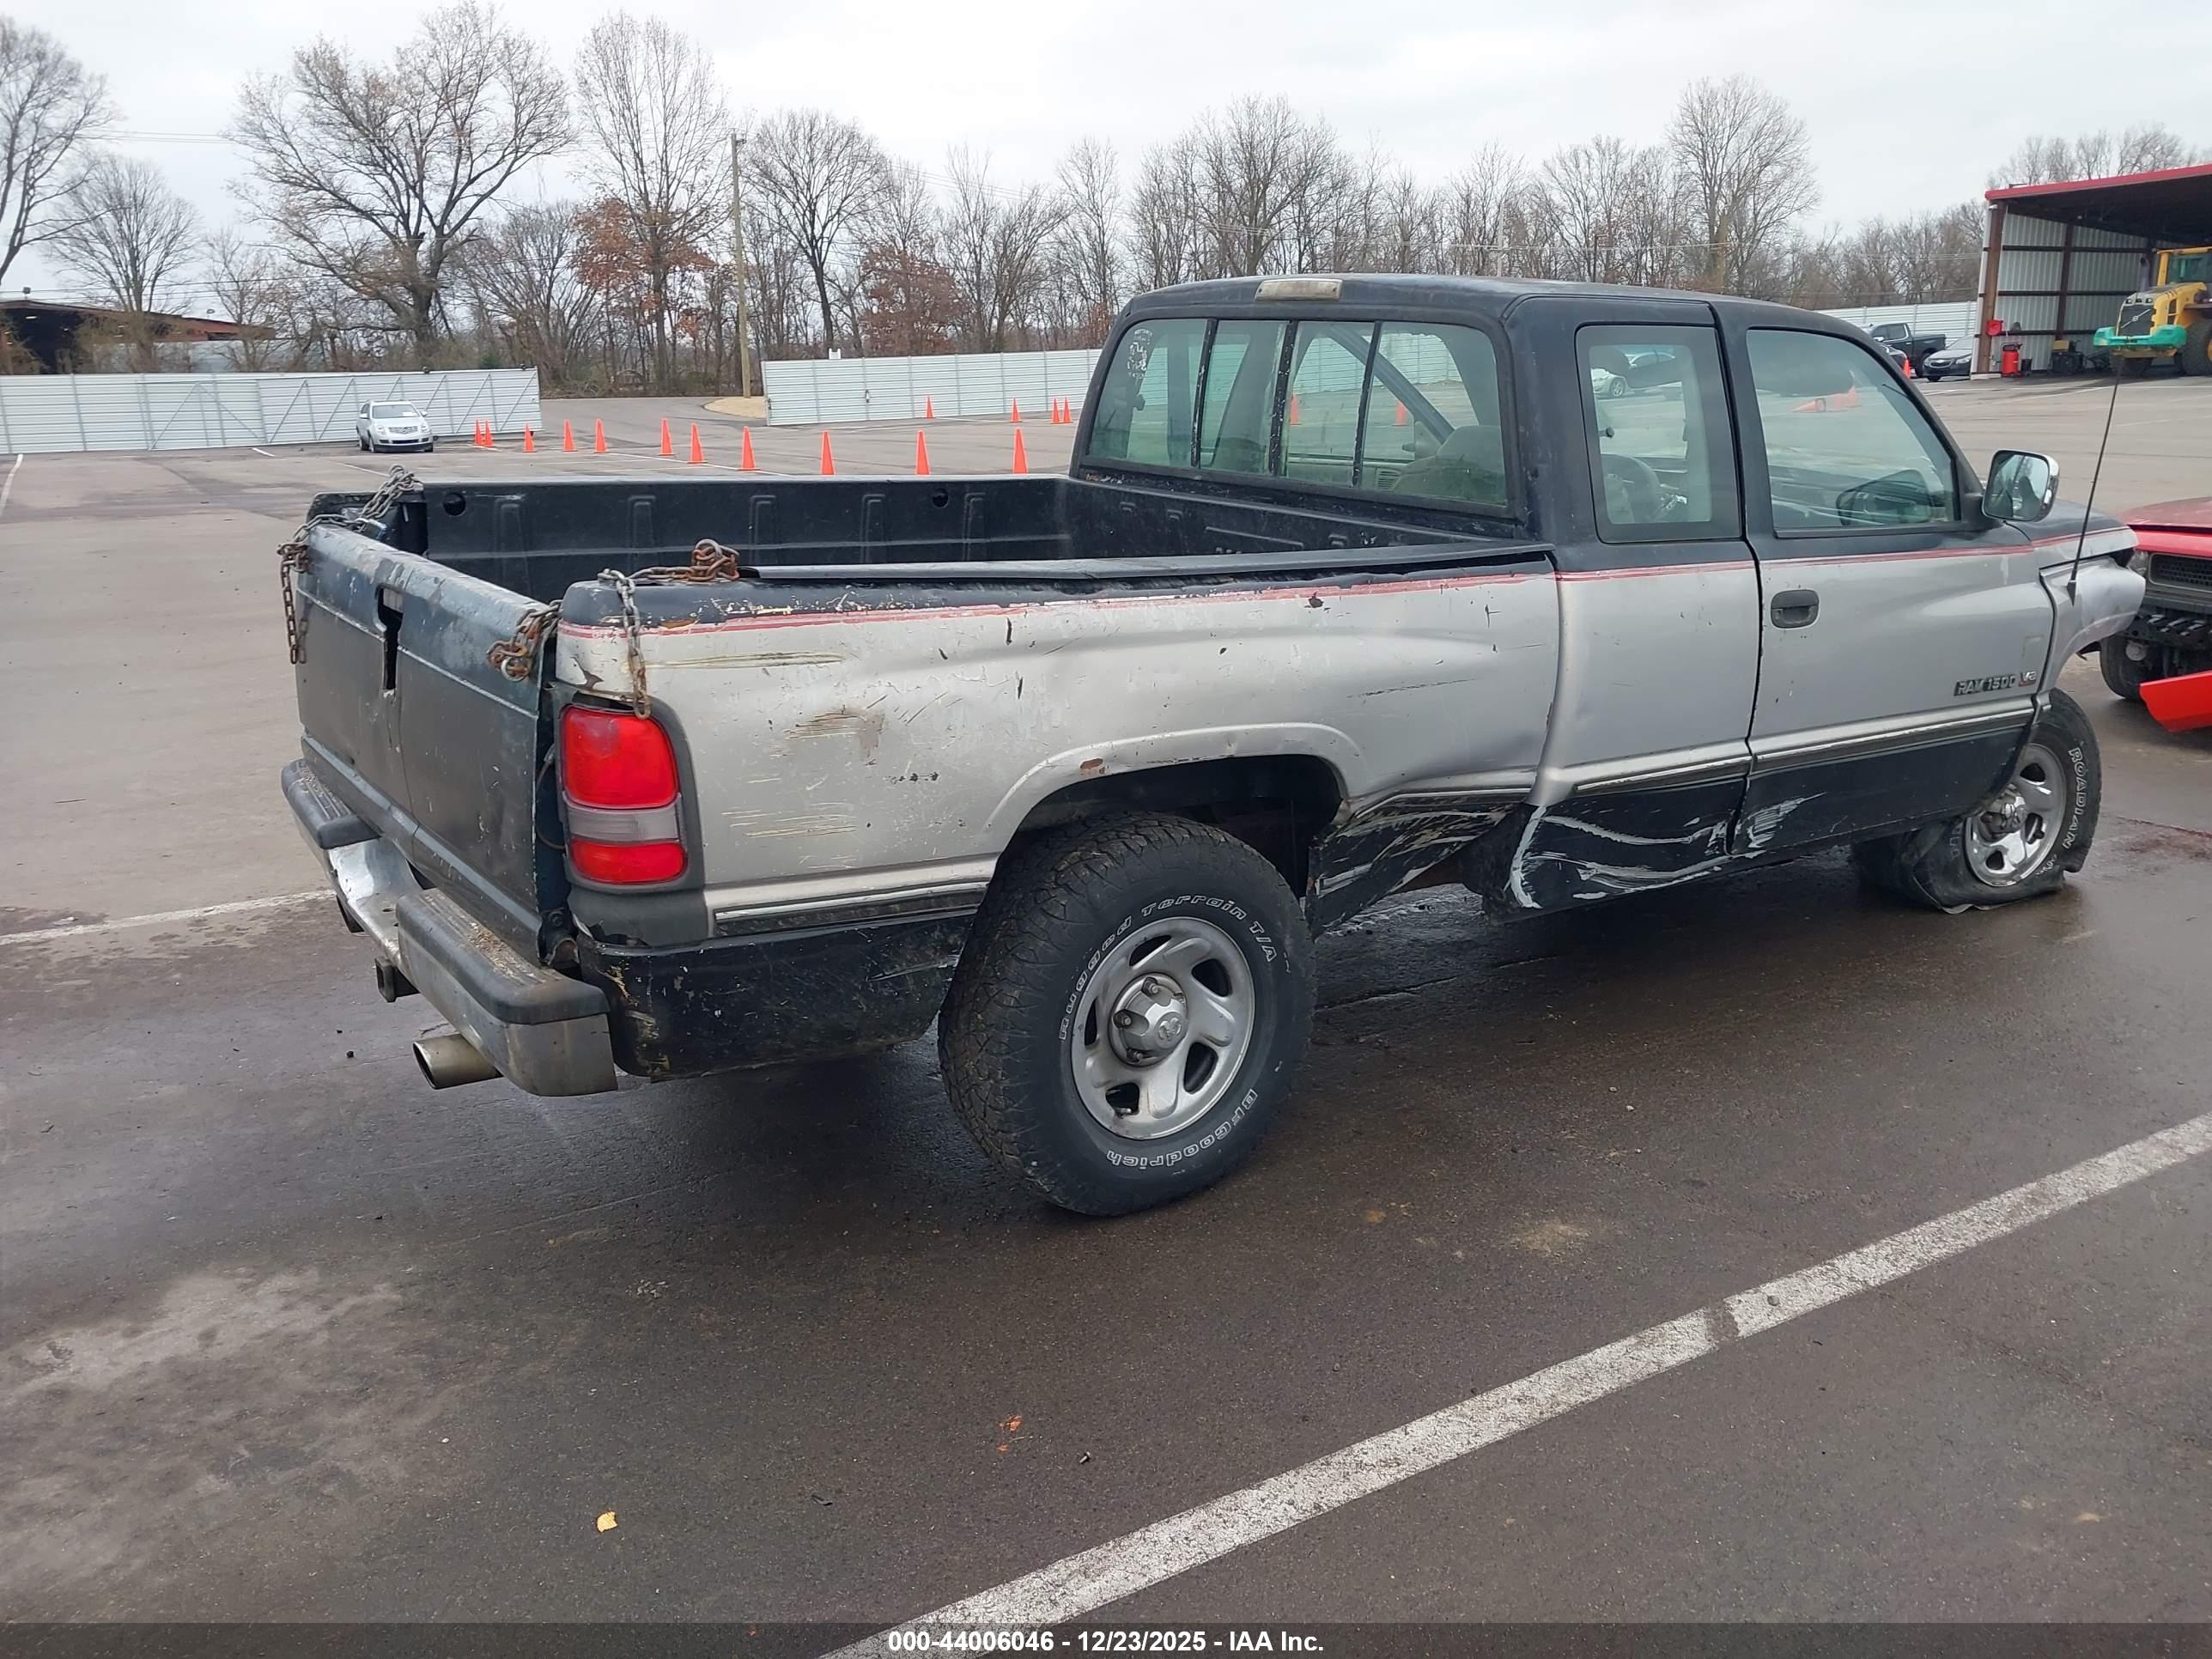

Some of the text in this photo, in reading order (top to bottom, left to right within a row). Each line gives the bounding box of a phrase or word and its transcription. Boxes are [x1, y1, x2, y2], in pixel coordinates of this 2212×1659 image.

[1955, 678, 1985, 695] RAM
[1986, 674, 2017, 691] 1500
[2062, 747, 2087, 850] ROADIAN
[1058, 895, 1278, 1041] Rugged Terrain T/A
[1106, 1088, 1258, 1170] BFGoodrich
